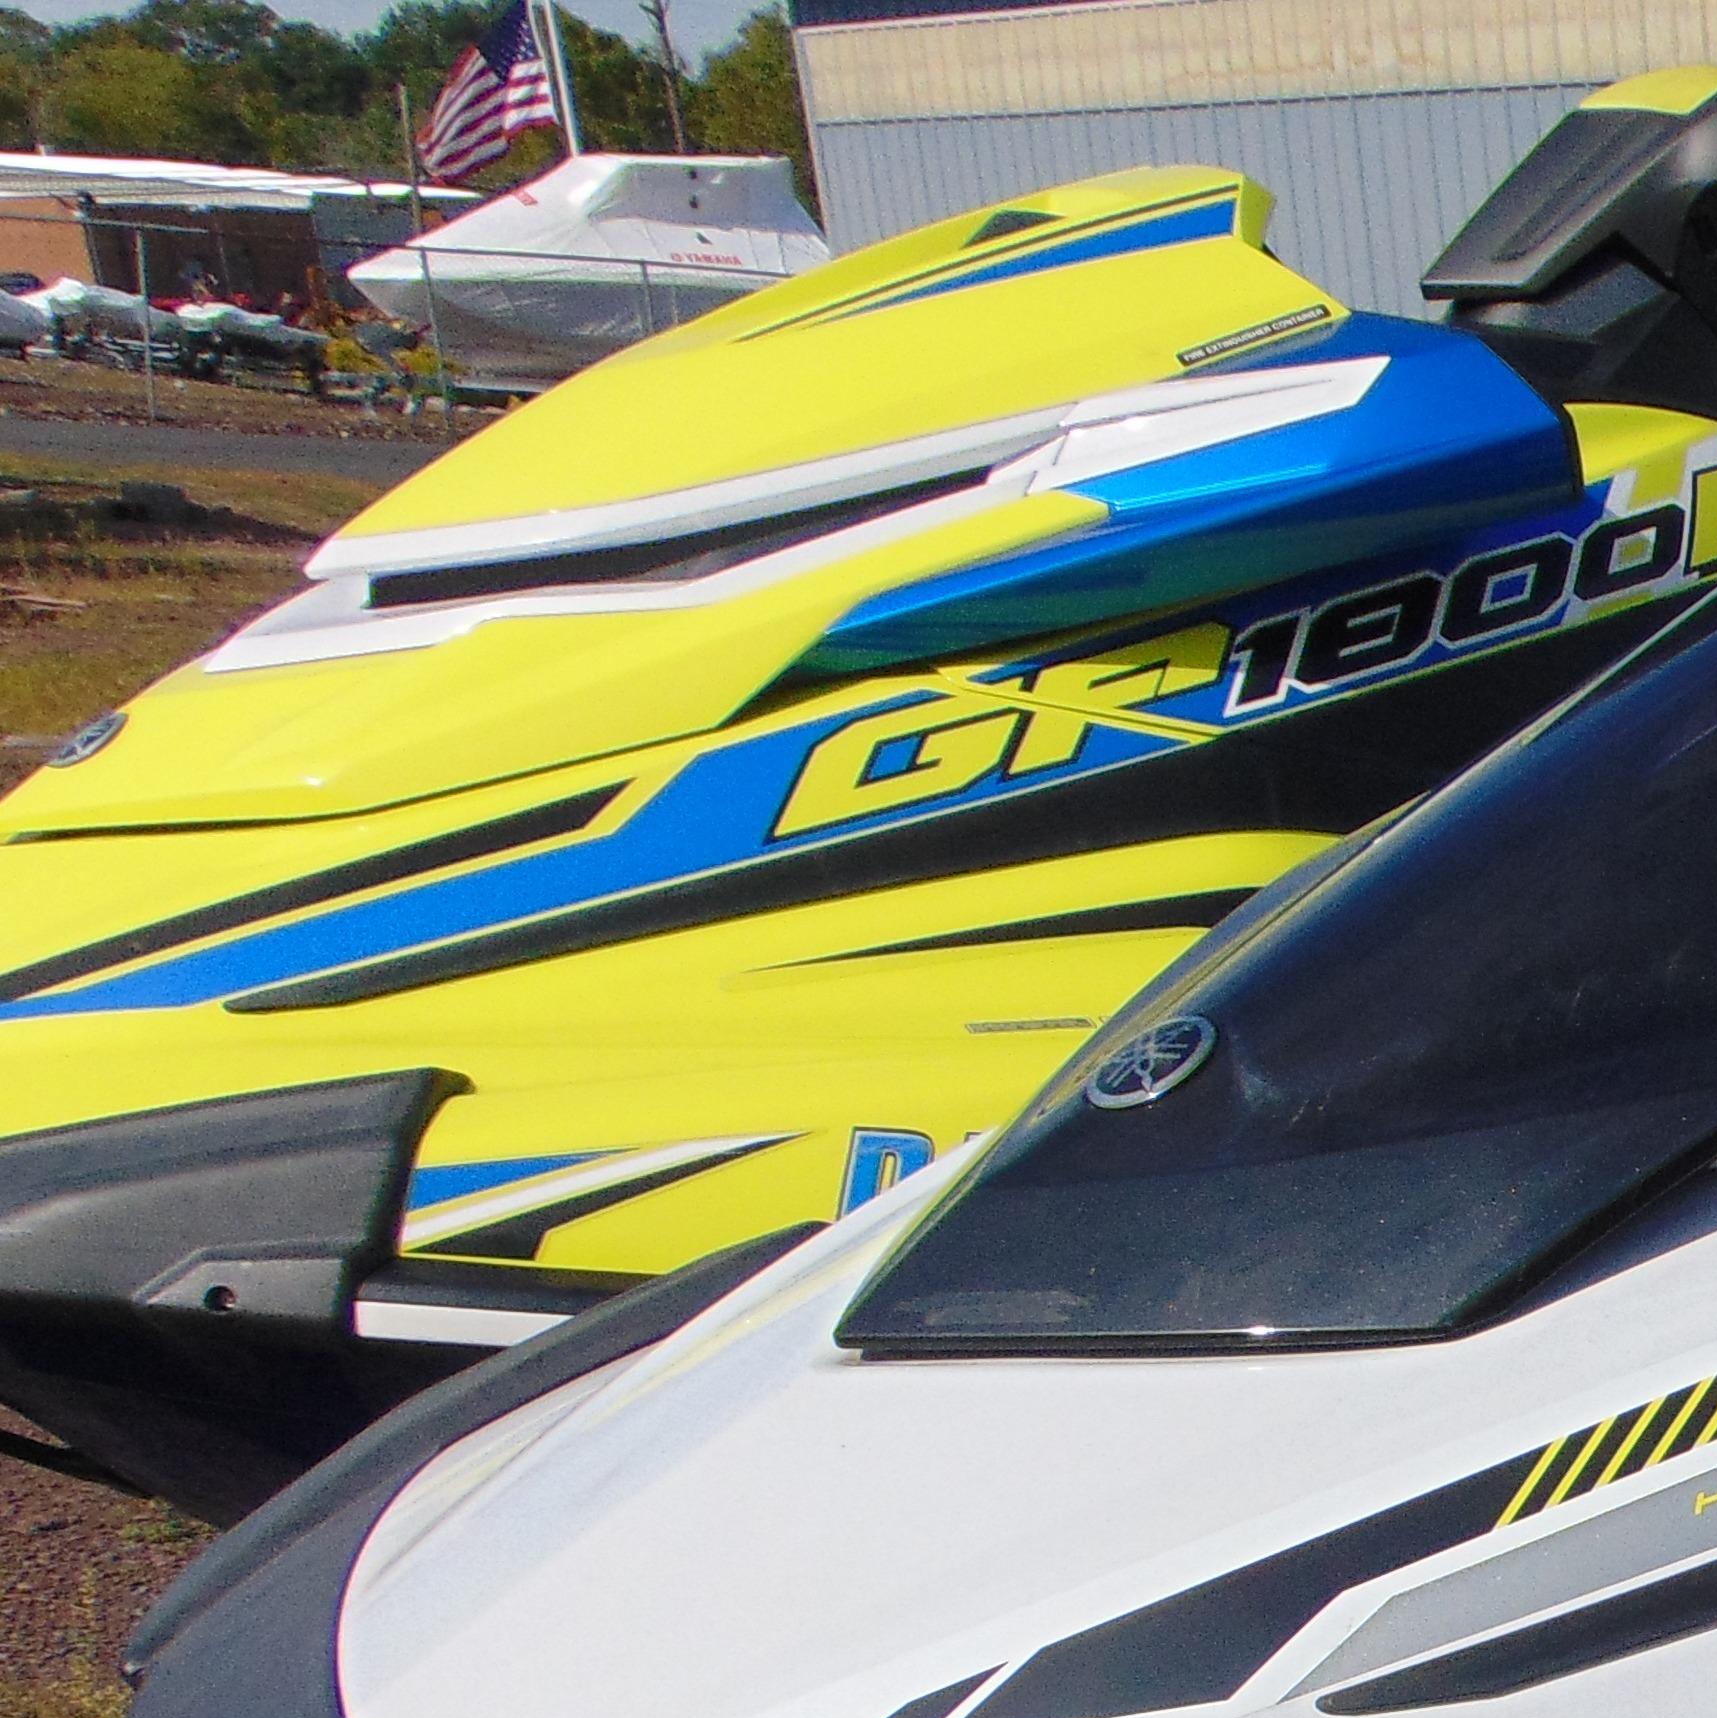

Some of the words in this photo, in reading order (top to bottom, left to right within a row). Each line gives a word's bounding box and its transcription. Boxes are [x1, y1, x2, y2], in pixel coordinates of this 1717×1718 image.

[1183, 350, 1205, 361] FIRE
[1205, 326, 1271, 354] EXTINGUISHER
[1271, 308, 1325, 330] CONTAINER
